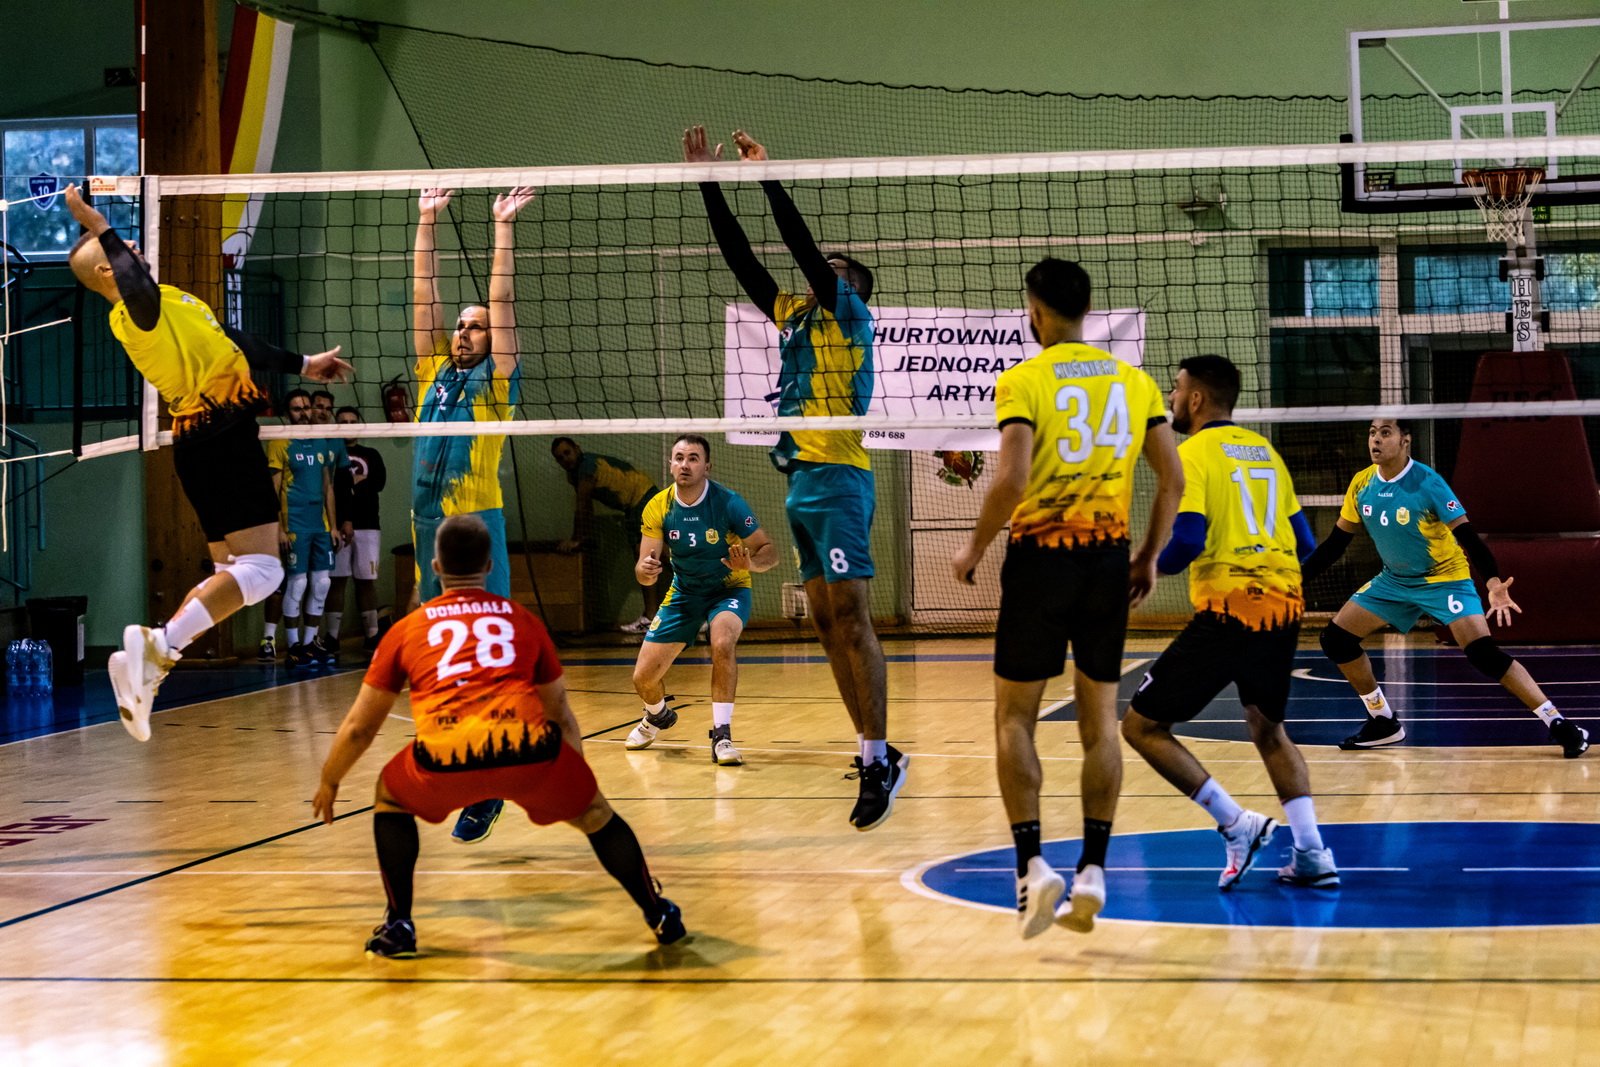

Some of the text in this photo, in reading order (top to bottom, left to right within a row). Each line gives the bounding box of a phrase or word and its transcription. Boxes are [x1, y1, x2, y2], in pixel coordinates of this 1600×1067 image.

[872, 327, 1023, 345] HURTOWNIA
[1055, 382, 1134, 463] 34
[888, 431, 905, 439] 688
[1230, 466, 1277, 538] 17
[1380, 510, 1389, 526] 6
[688, 532, 697, 547] 3
[829, 547, 849, 574] 8
[728, 598, 739, 609] 3
[1447, 594, 1464, 614] 6
[427, 616, 517, 681] 28
